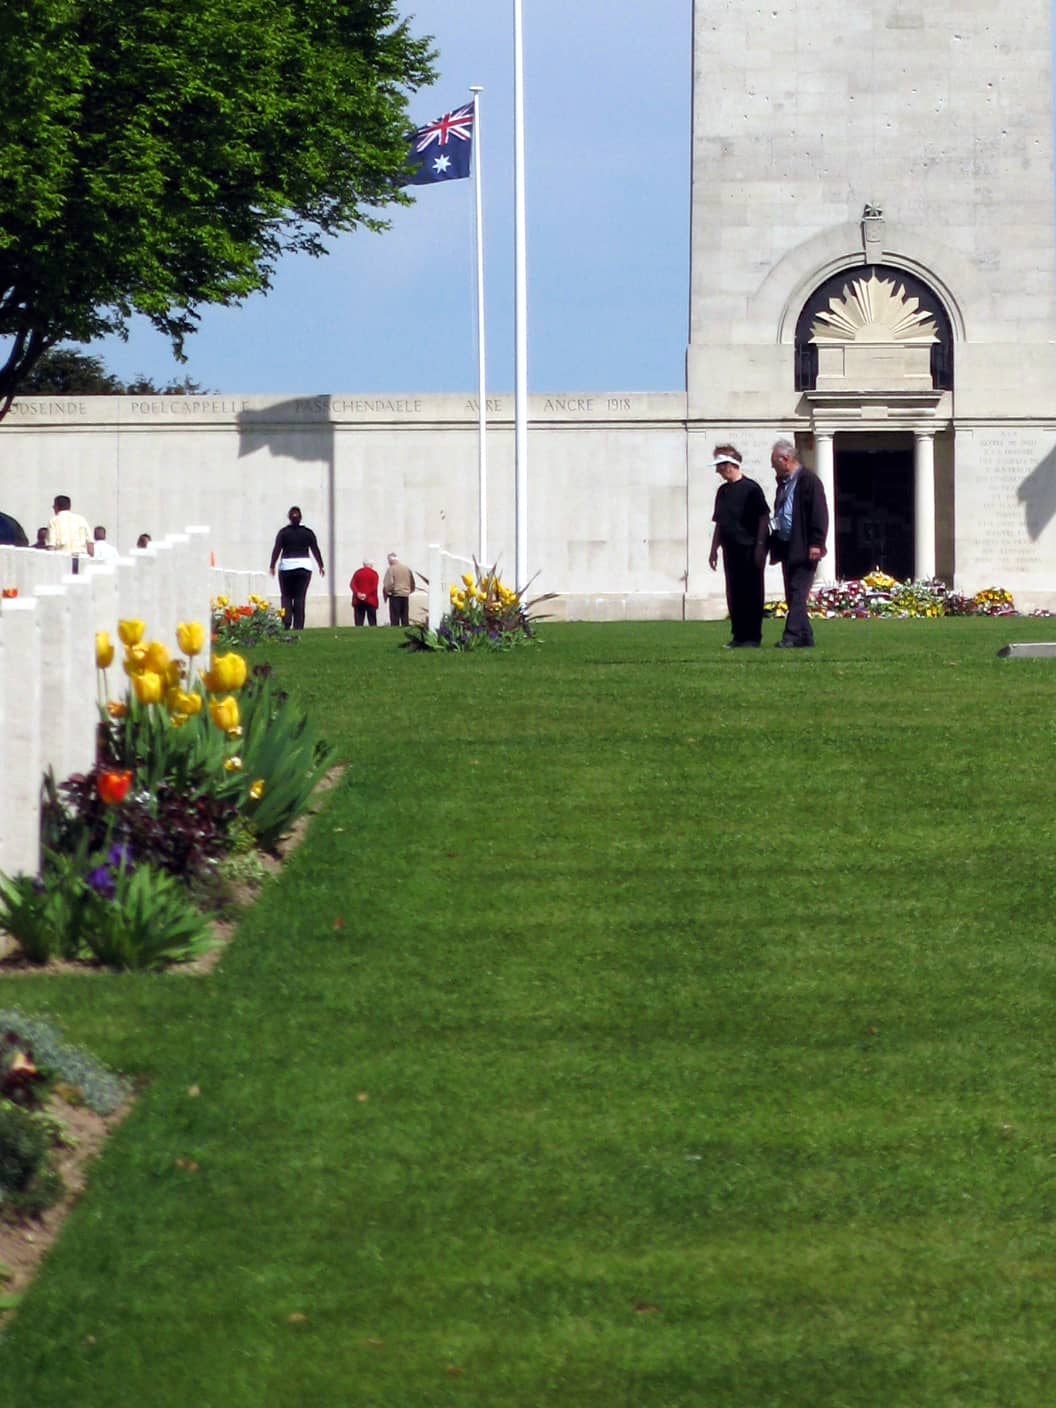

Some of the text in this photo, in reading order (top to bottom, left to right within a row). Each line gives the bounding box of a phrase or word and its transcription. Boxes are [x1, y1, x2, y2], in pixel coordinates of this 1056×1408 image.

[131, 401, 249, 414] POELCAPPELLE
[296, 400, 423, 413] PASSCHENDAELE
[543, 398, 594, 412] ANCRE
[607, 398, 631, 411] 1918
